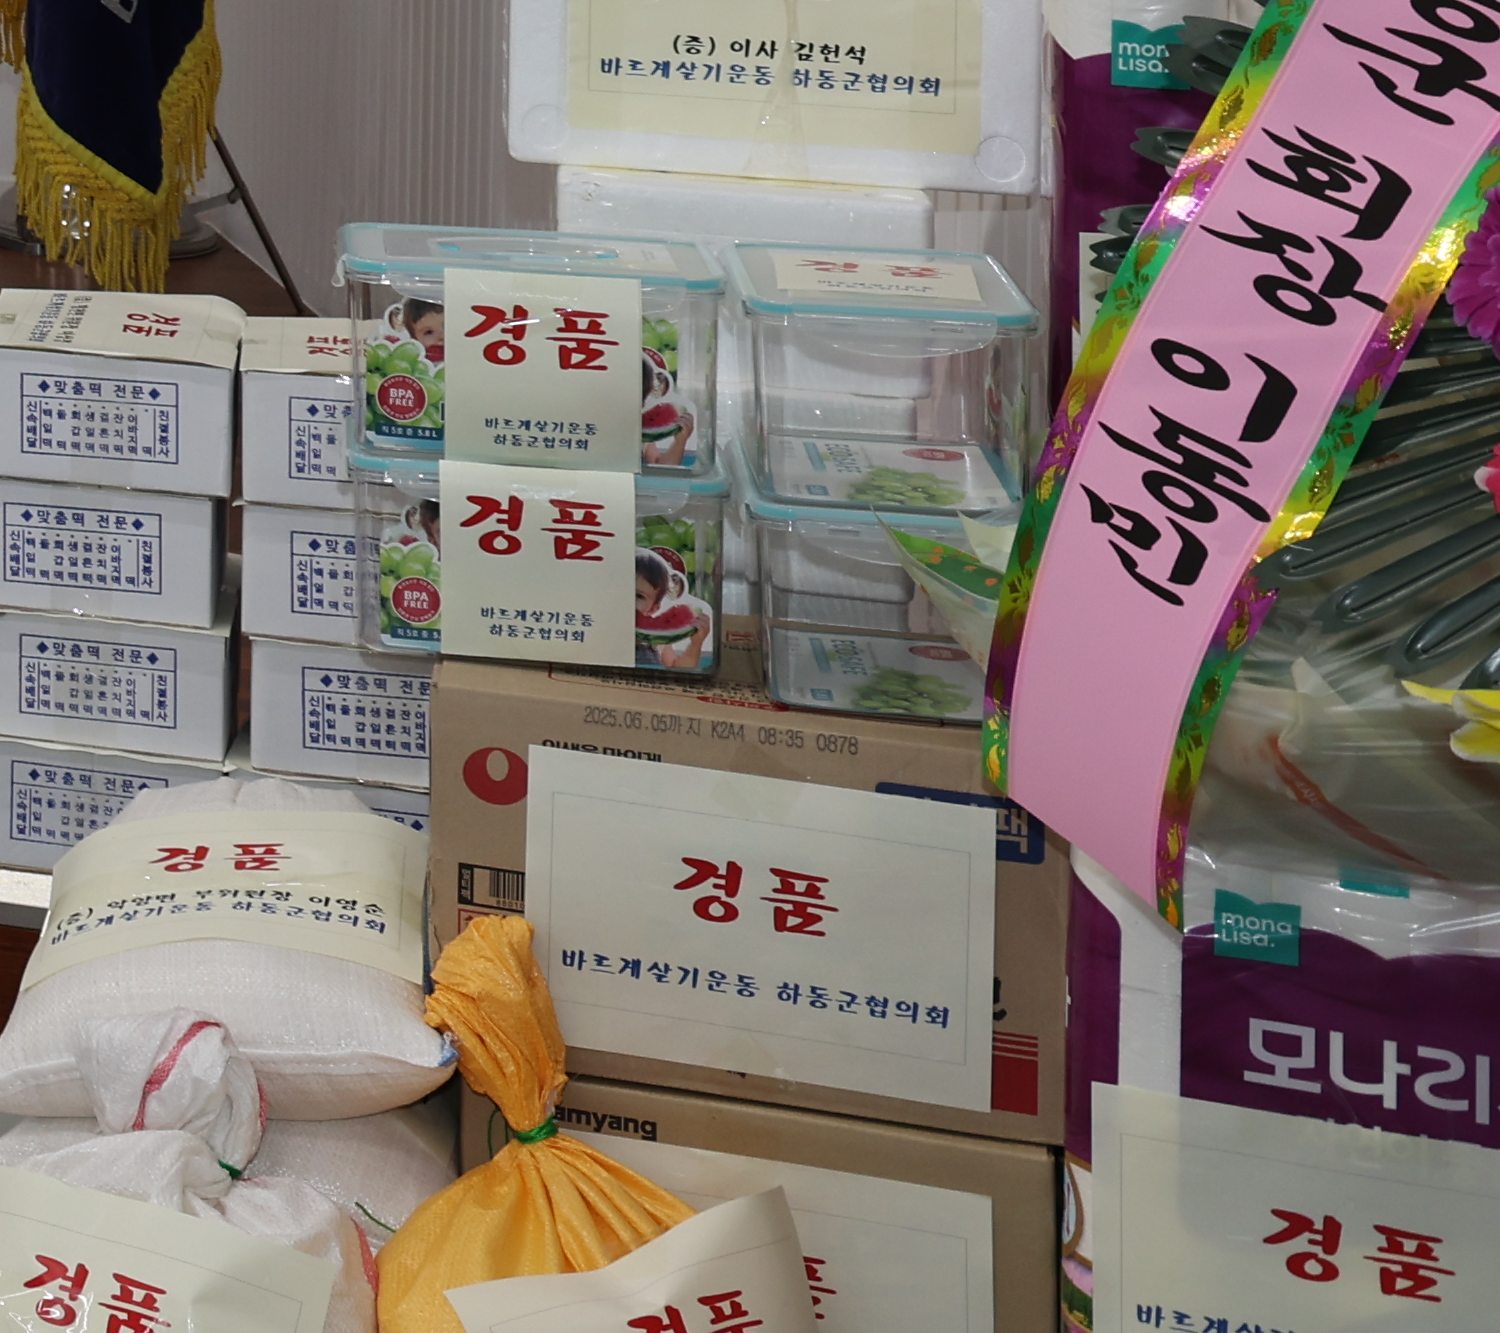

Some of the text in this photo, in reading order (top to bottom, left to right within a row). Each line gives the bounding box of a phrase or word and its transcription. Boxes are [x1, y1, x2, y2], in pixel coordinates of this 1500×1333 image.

[673, 35, 866, 63] (증) 이사 김헌석
[600, 57, 941, 96] 바르게살기운동 하동군협의회
[465, 304, 619, 371] 경품
[54, 381, 145, 398] 맞춤떡 전문
[390, 388, 414, 399] BPA
[389, 398, 413, 407] FREE
[485, 417, 598, 434] 바르게살기운동
[493, 433, 588, 450] 하동군협의회
[460, 495, 614, 561] 경품
[480, 607, 595, 626] 바르게살기운동
[489, 623, 585, 642] 하동군협의회
[757, 725, 858, 755] 08:35 0878
[675, 856, 839, 937] 경품
[1221, 911, 1293, 935] mona
[1263, 1208, 1456, 1302] 경품
